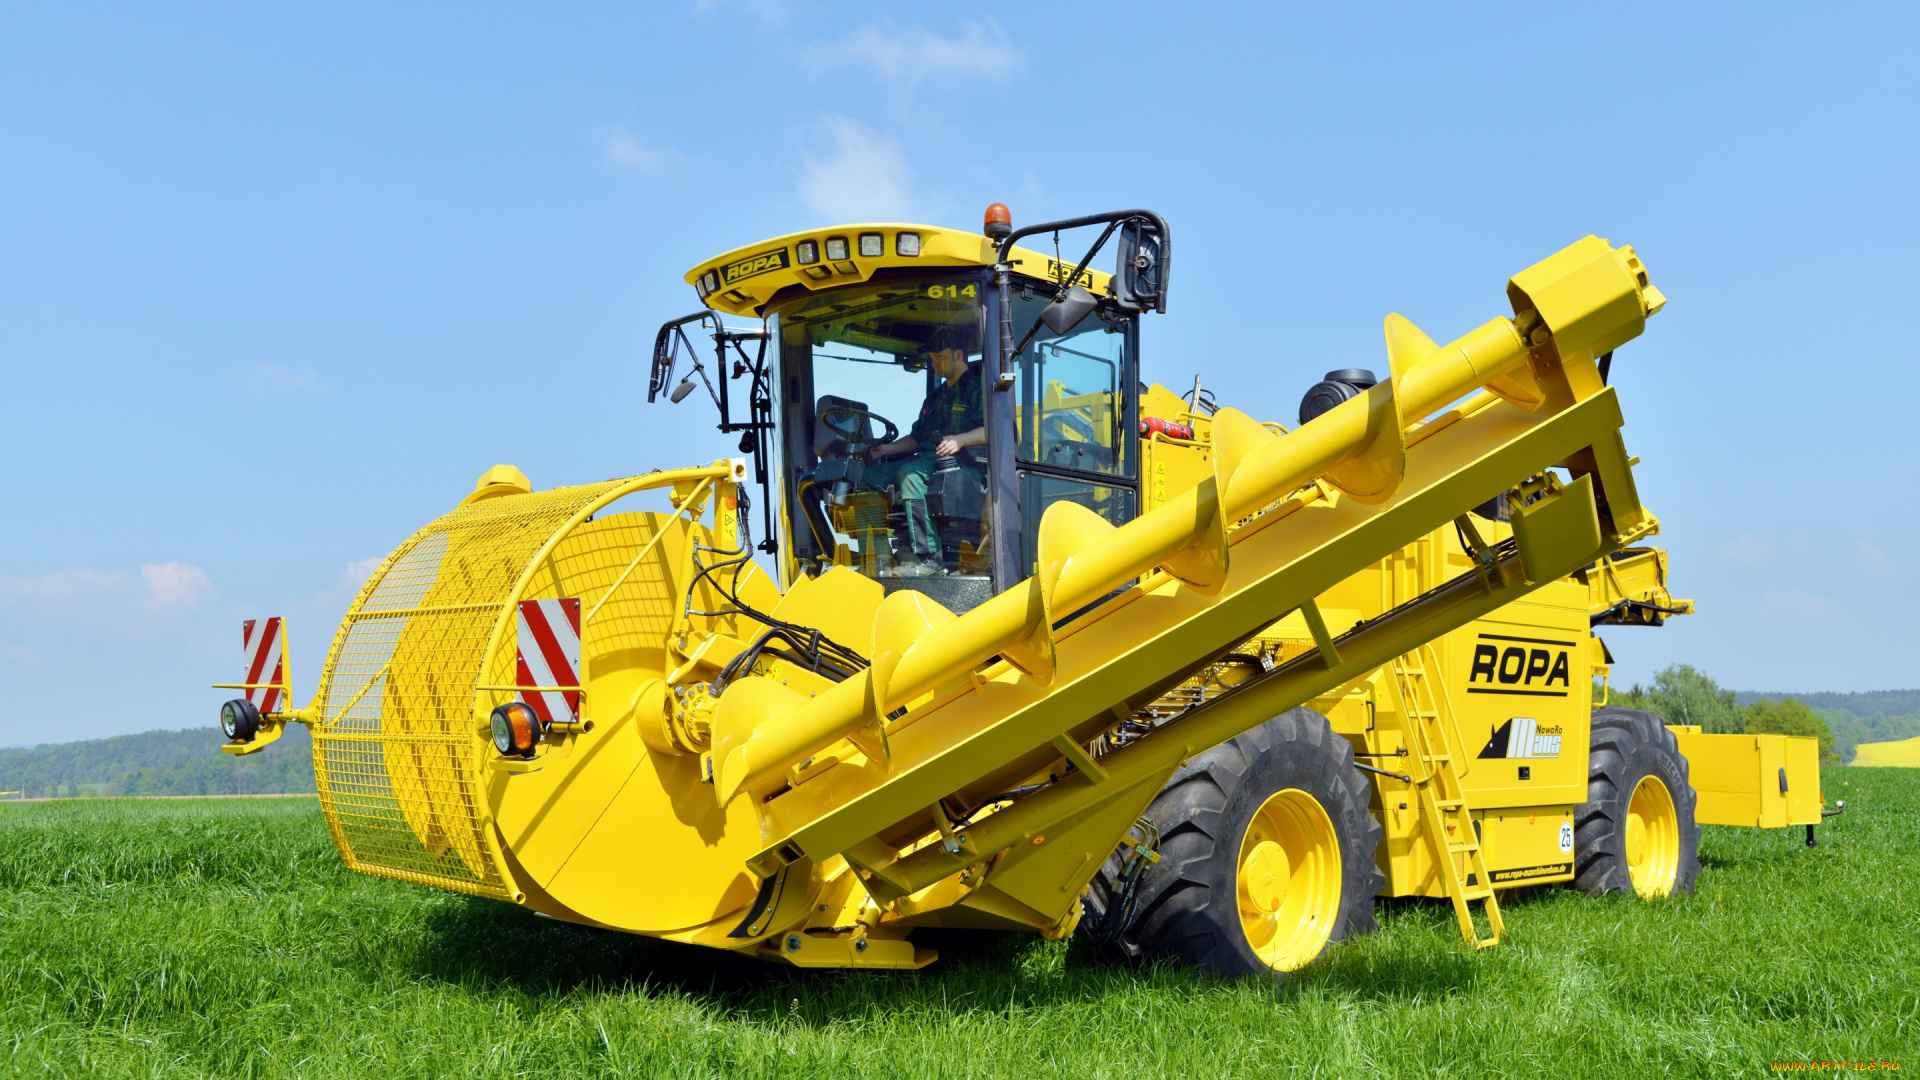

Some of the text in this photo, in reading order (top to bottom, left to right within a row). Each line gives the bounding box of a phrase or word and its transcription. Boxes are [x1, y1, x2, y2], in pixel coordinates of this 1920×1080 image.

[727, 254, 782, 281] ROPA
[927, 284, 977, 299] 614
[1469, 643, 1570, 687] ROPA
[1561, 828, 1571, 848] 25
[1495, 863, 1567, 880] www.ropa-maschinenbau.de
